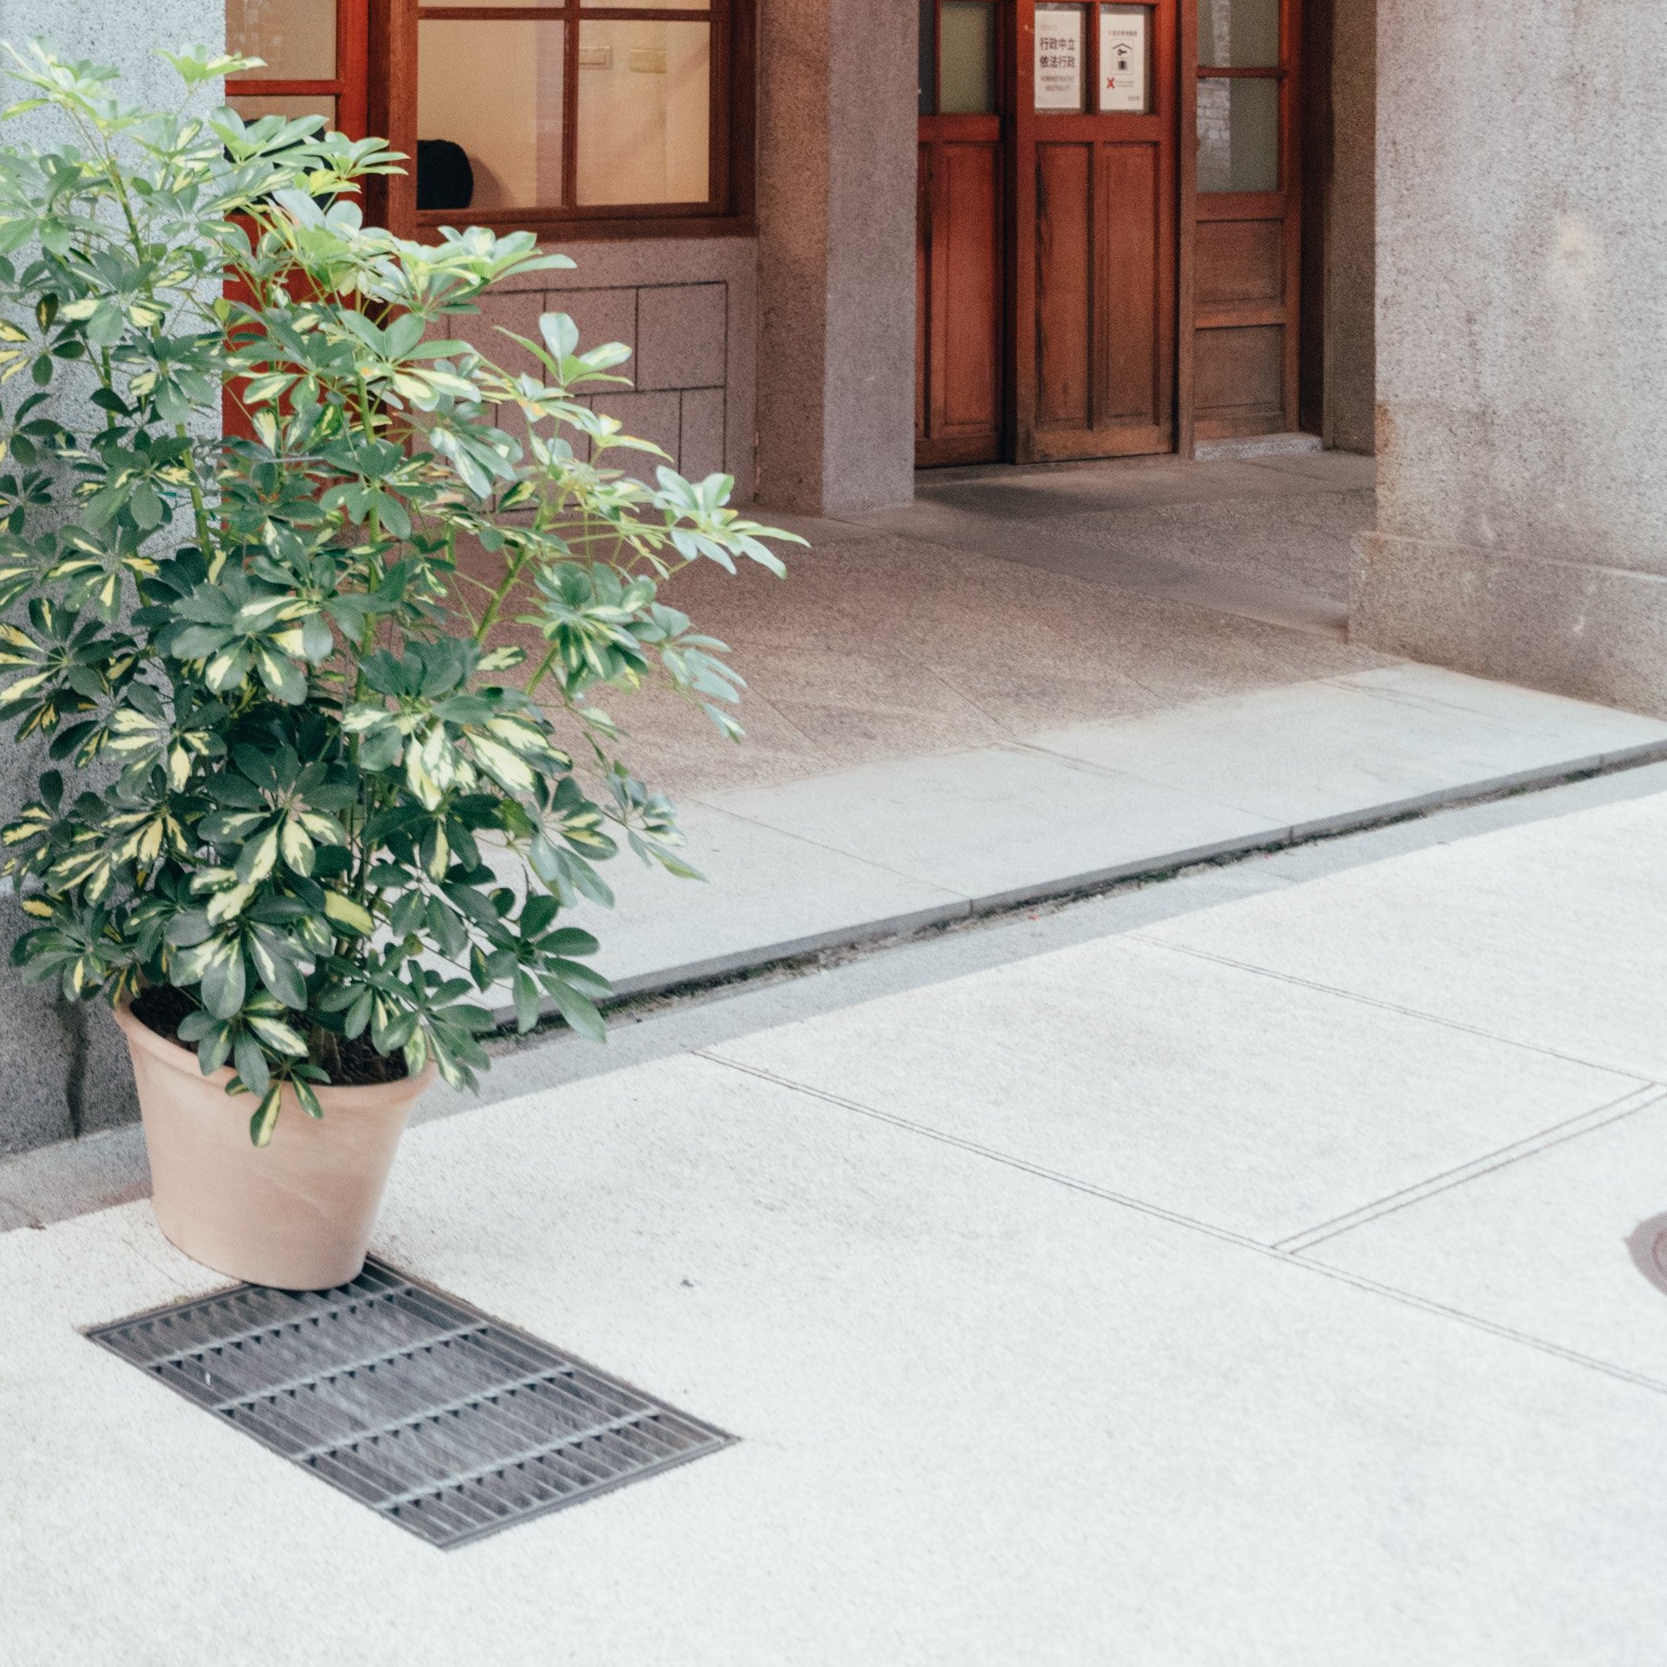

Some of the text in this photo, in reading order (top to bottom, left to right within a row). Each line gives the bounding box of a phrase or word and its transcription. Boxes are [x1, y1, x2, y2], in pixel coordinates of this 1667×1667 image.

[1040, 37, 1075, 51] 行政中立
[1040, 55, 1075, 69] 依法行政
